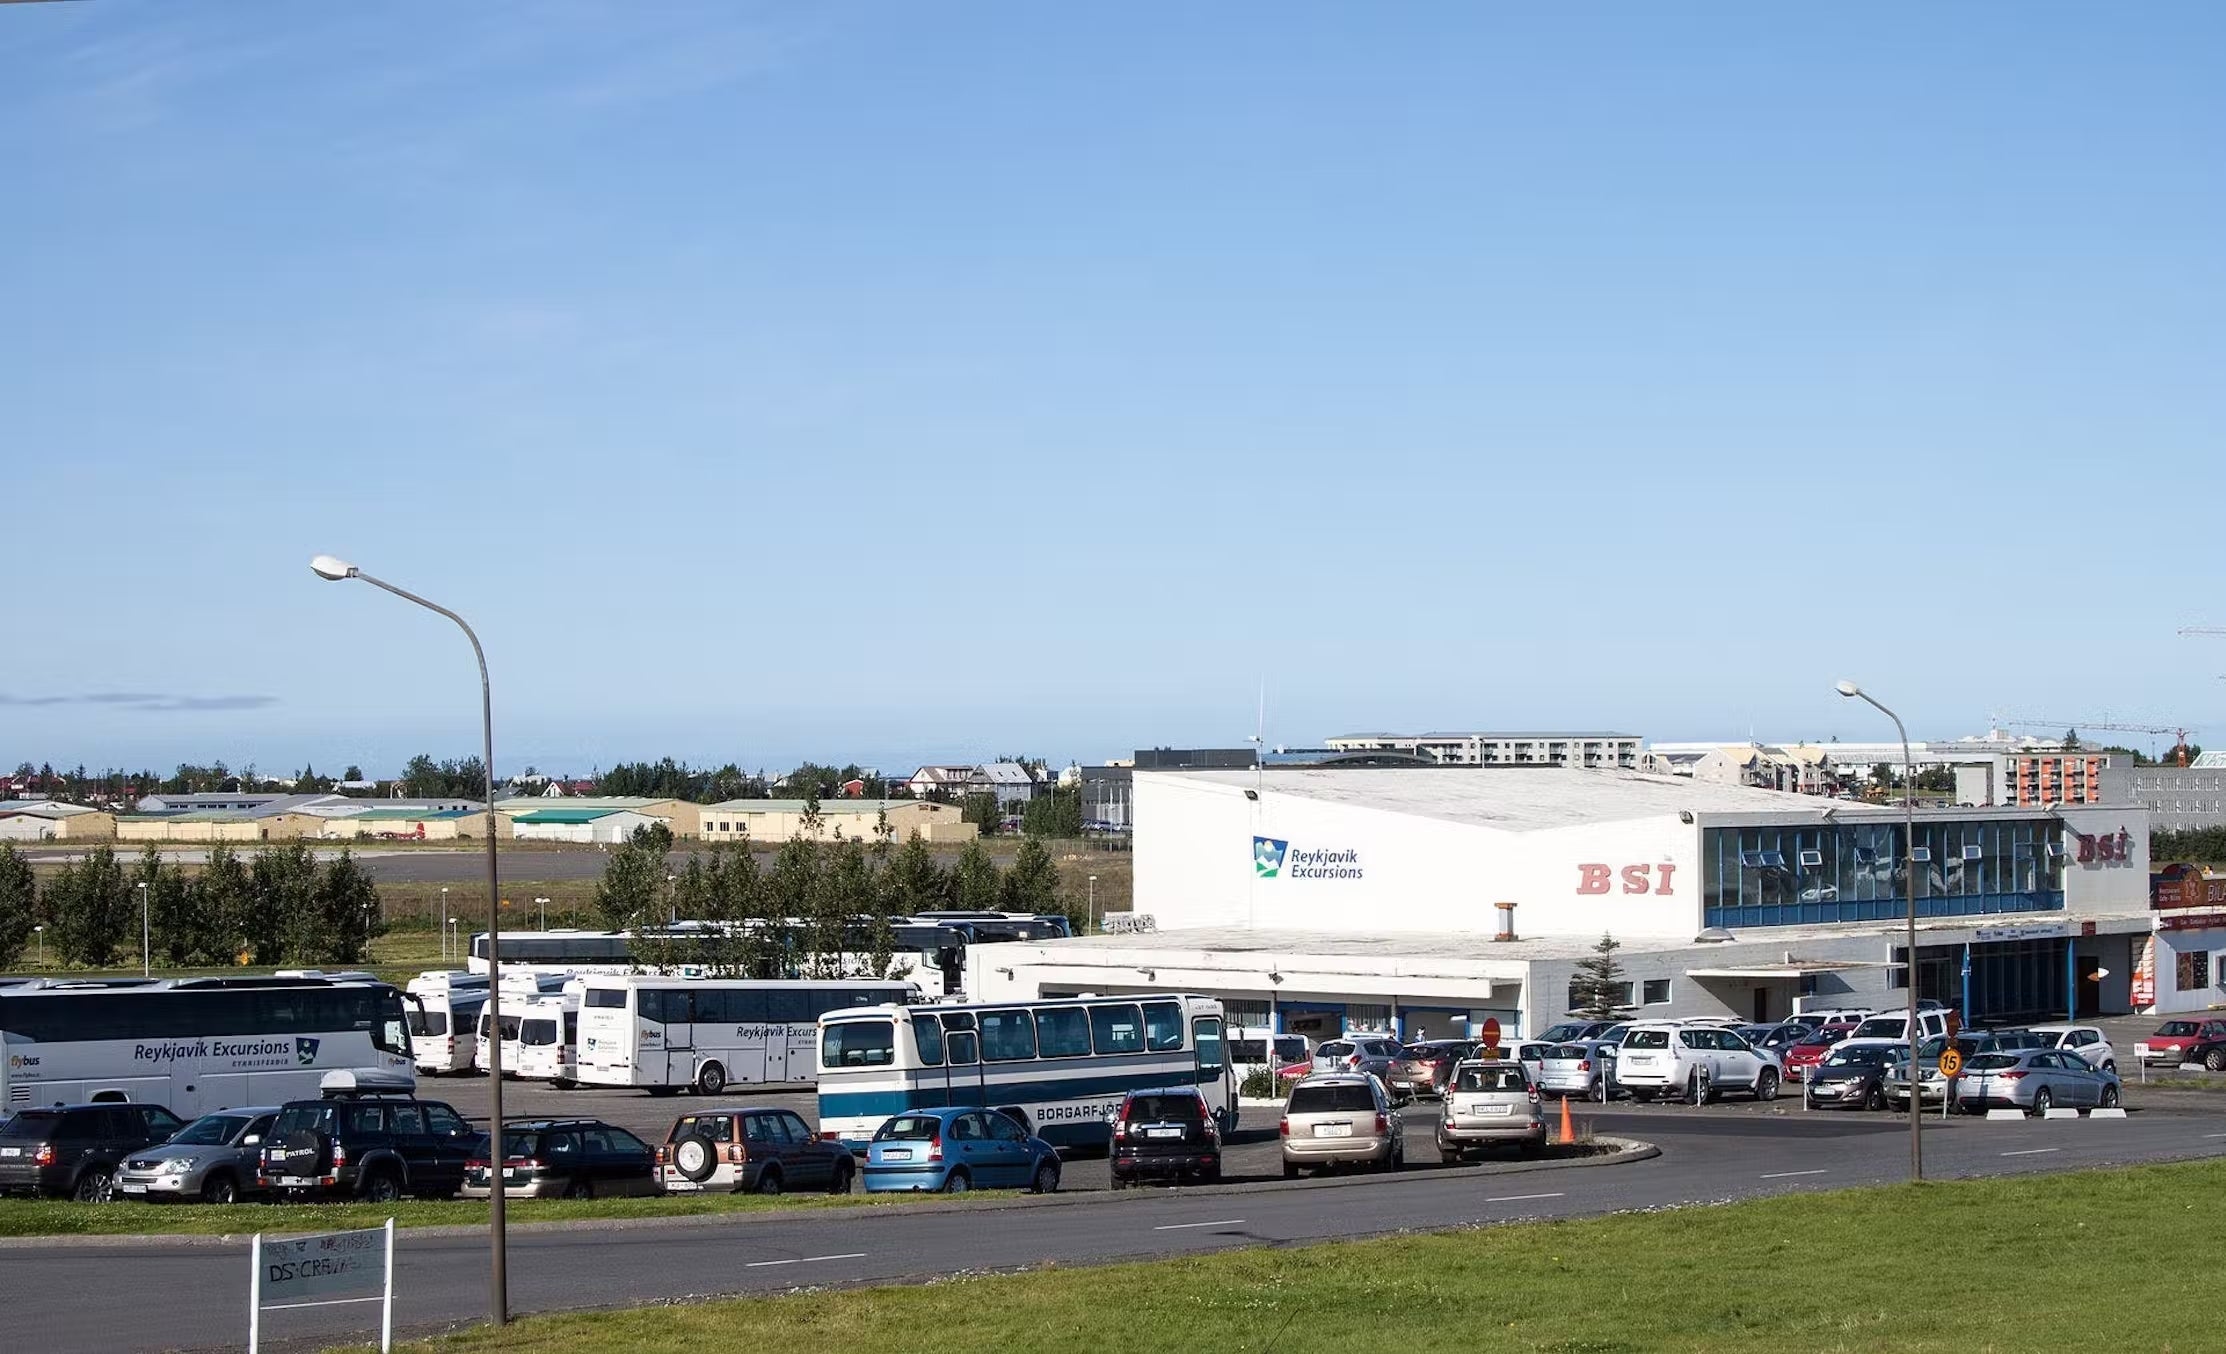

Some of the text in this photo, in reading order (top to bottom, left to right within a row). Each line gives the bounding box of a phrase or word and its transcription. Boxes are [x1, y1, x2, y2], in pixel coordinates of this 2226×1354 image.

[1291, 848, 1358, 867] Reykjavik
[1291, 864, 1363, 880] Excursions
[736, 1025, 785, 1040] Reykjavik
[134, 1039, 290, 1063] Reykjavik Excursions
[10, 1055, 40, 1069] flybus
[1943, 1054, 1957, 1071] 15
[286, 1147, 315, 1158] PATROL
